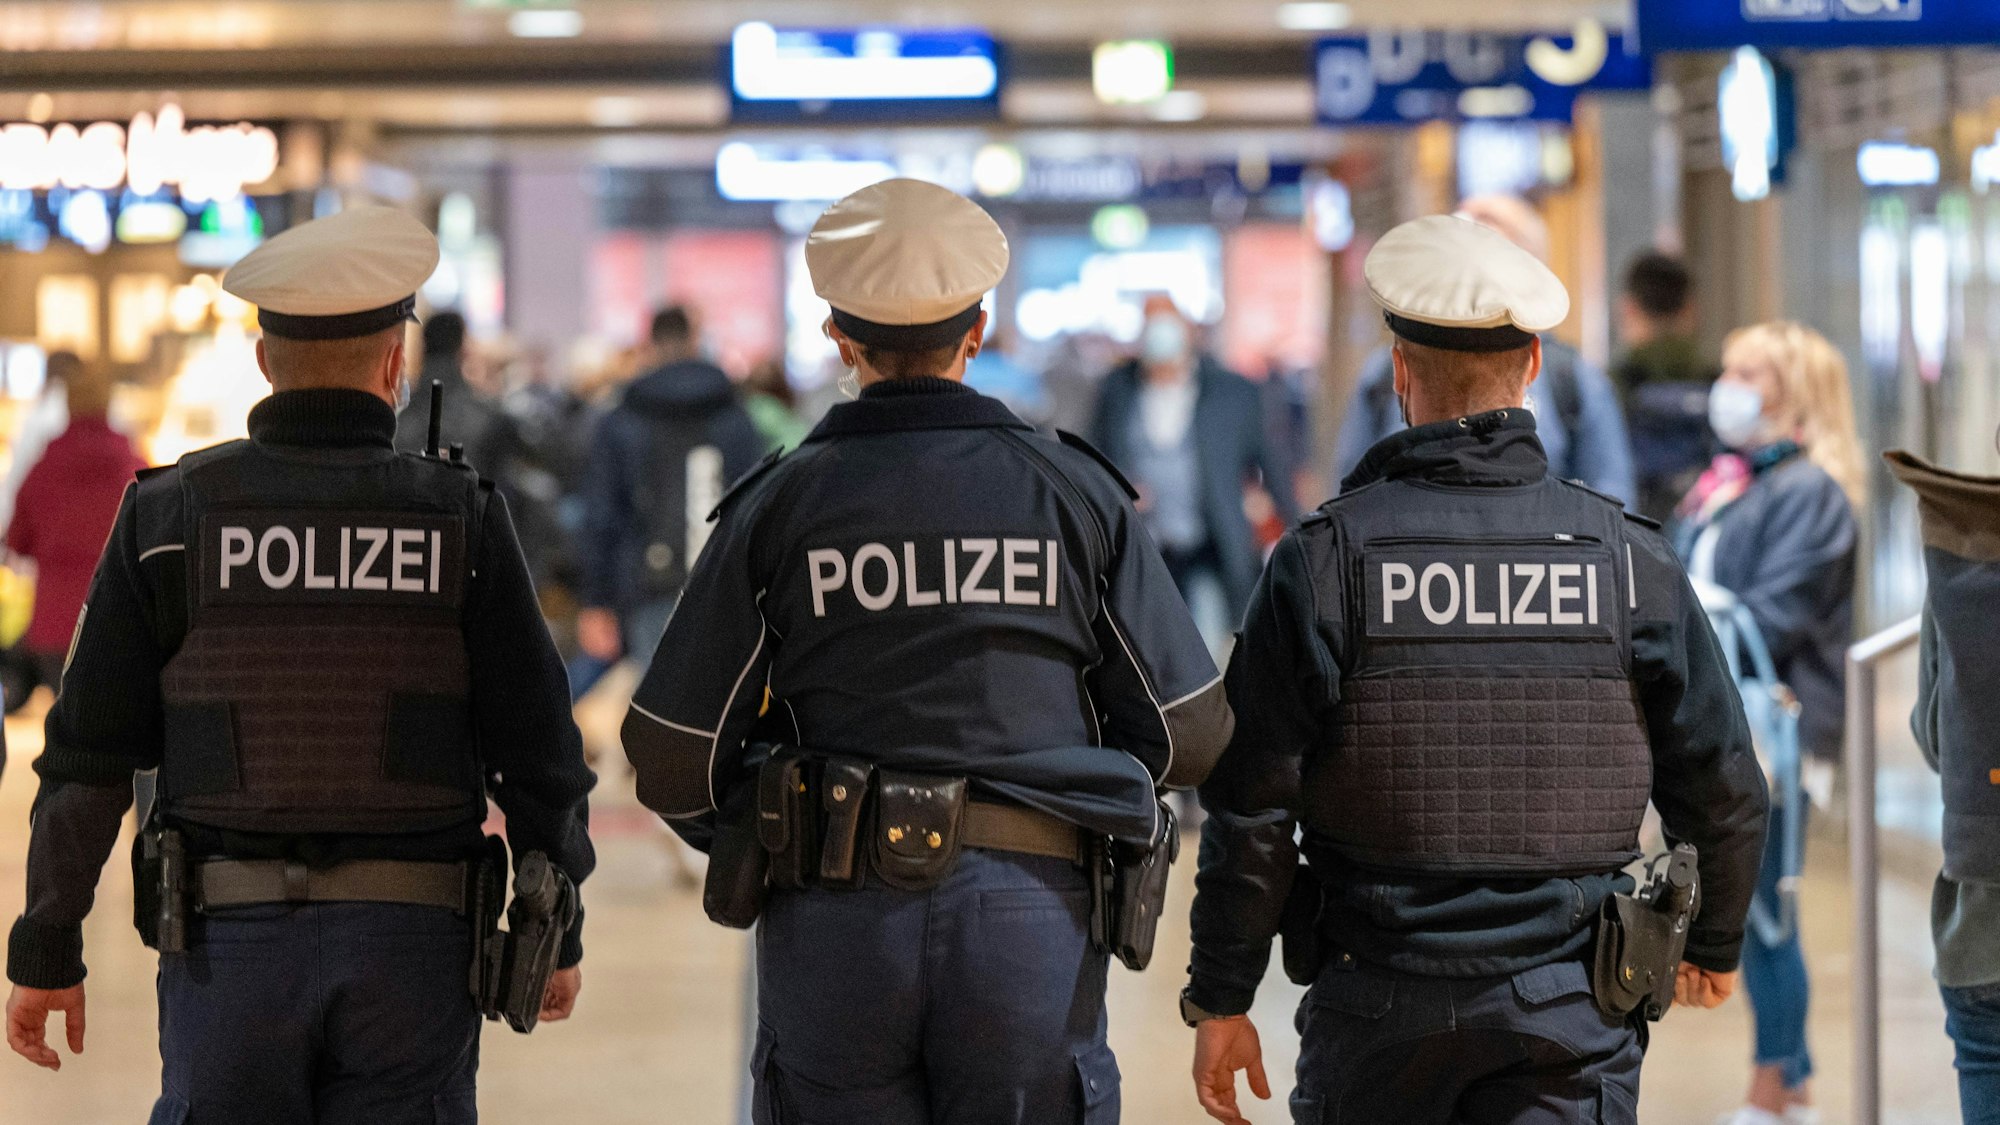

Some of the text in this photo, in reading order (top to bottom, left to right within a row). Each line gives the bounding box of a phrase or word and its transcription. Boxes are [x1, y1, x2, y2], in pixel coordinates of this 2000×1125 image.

[220, 525, 441, 593] POLIZEI
[807, 538, 1058, 617] POLIZEI
[1382, 562, 1598, 625] POLIZEI
